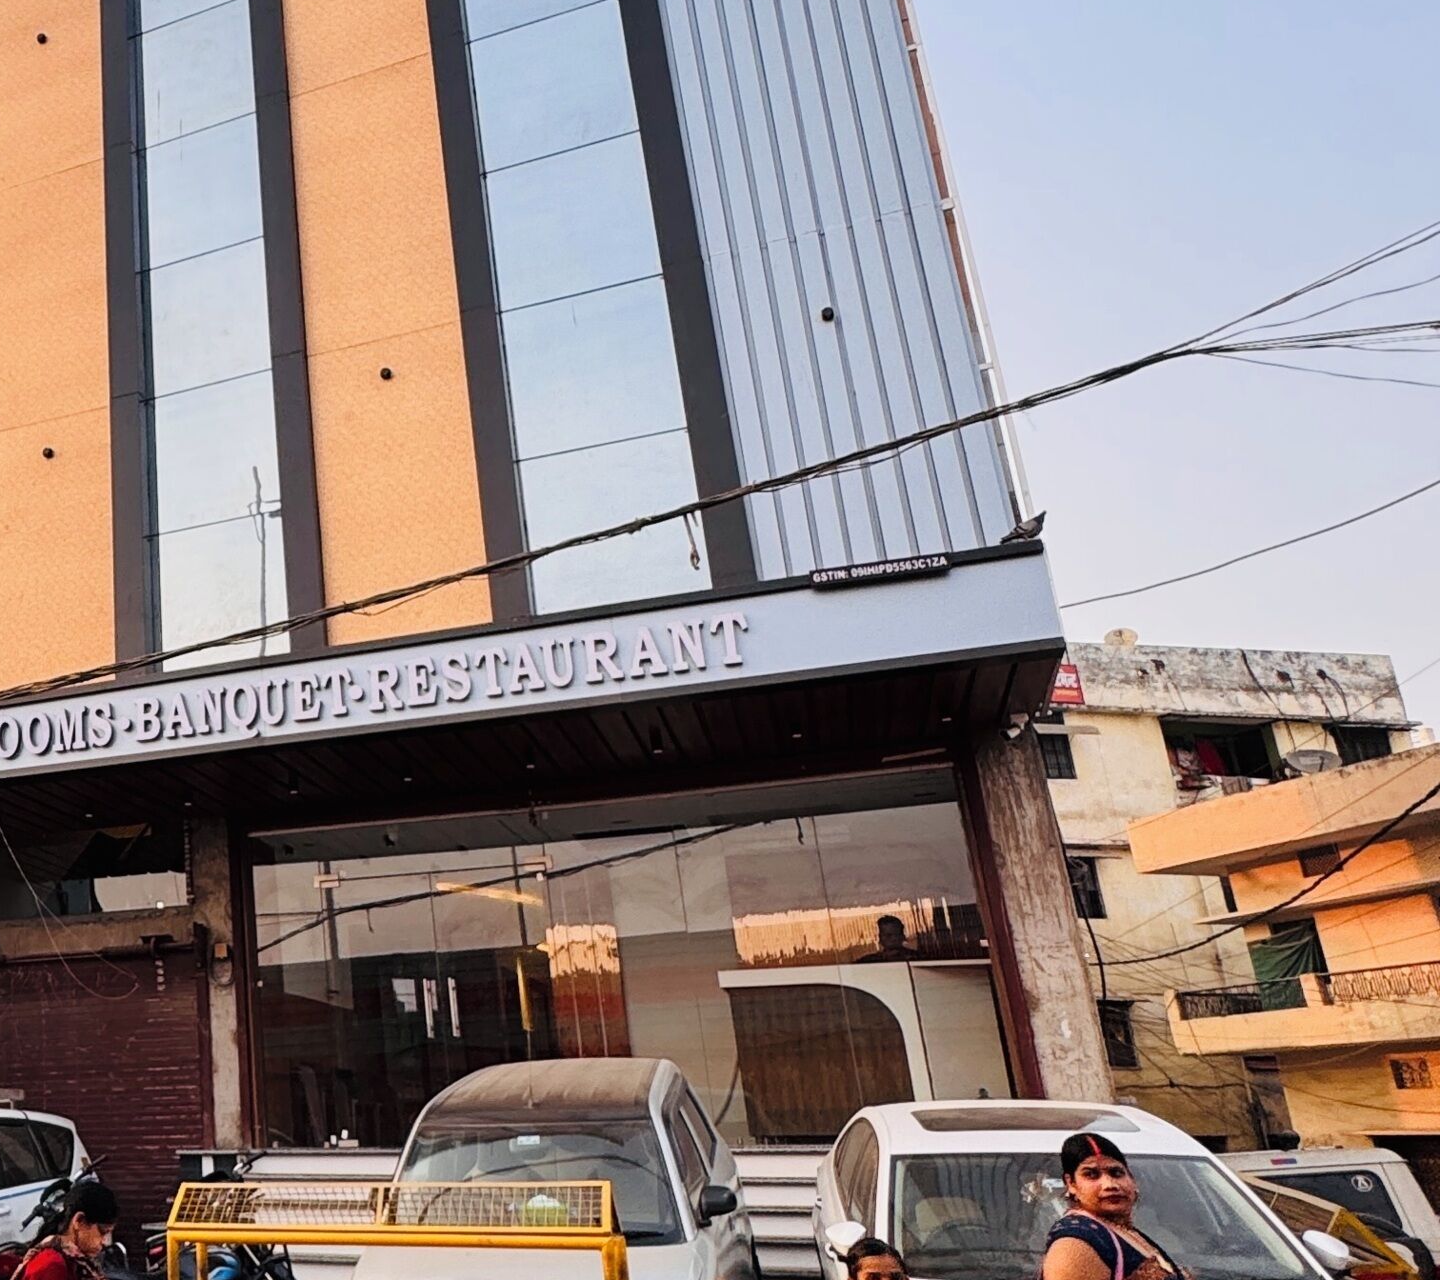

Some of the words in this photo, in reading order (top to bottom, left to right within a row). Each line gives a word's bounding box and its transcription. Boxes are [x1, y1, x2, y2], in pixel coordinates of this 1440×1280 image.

[812, 569, 849, 583] GSTIN:
[135, 667, 353, 744] BANQUET
[368, 611, 749, 713] RESTAURANT
